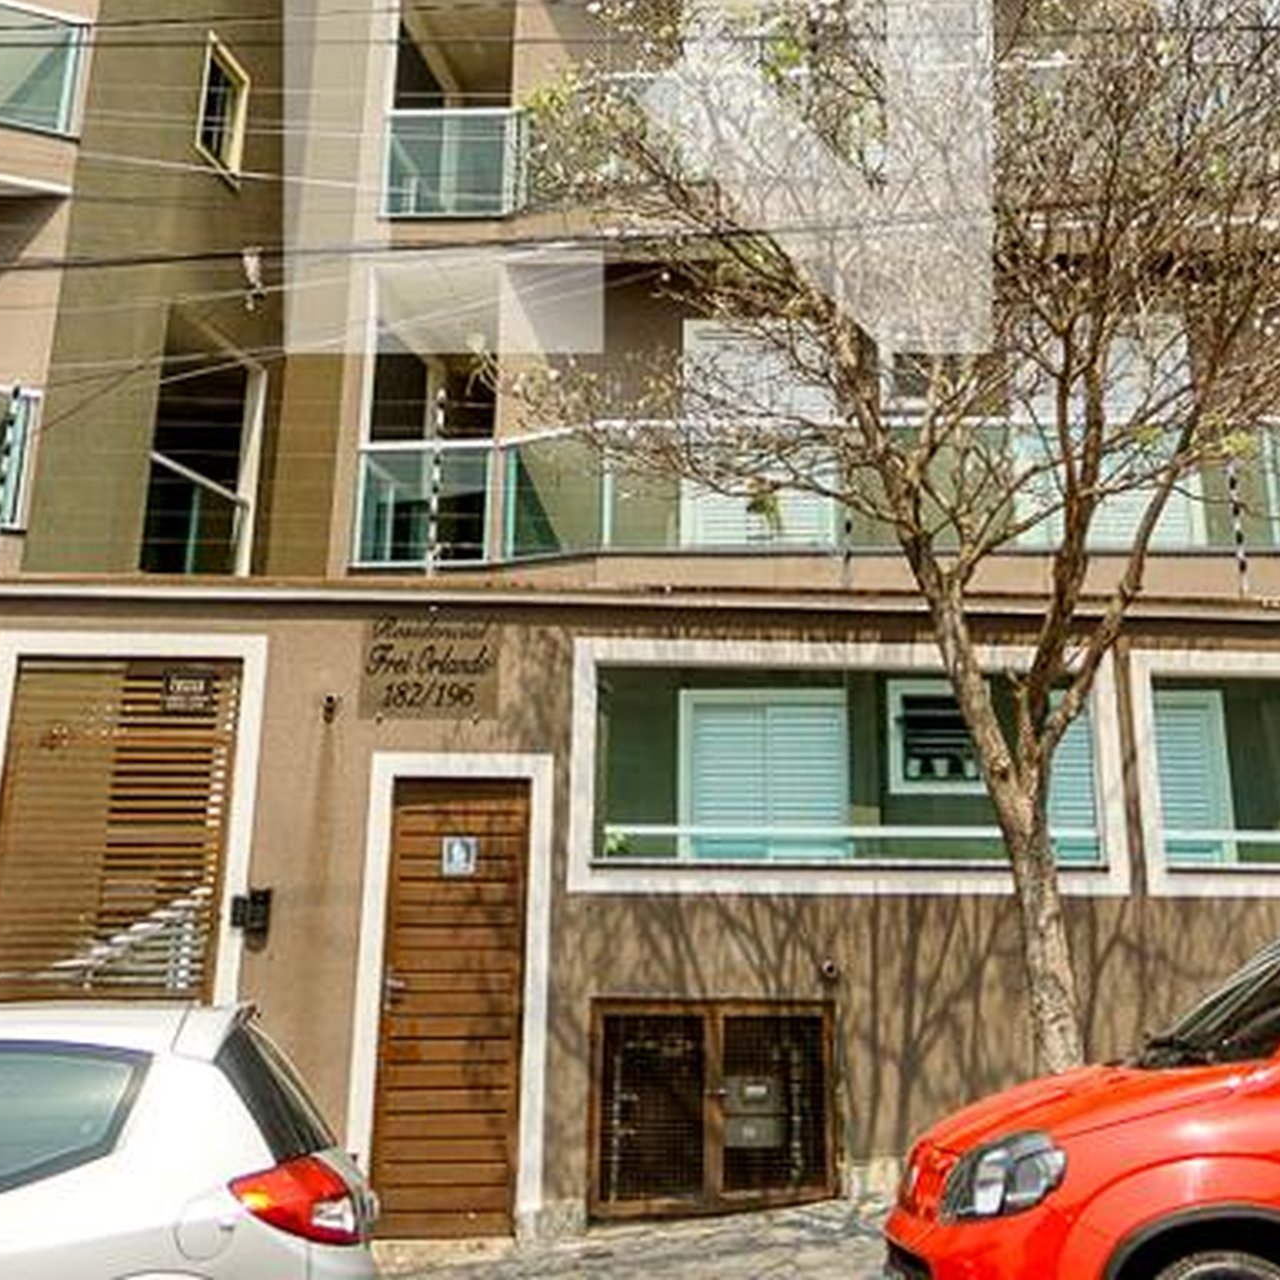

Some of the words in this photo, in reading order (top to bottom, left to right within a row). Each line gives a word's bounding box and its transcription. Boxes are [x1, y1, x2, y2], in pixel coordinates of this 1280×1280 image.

[365, 643, 415, 676] Frei
[417, 643, 498, 676] Orlando
[383, 680, 476, 709] 182/196
